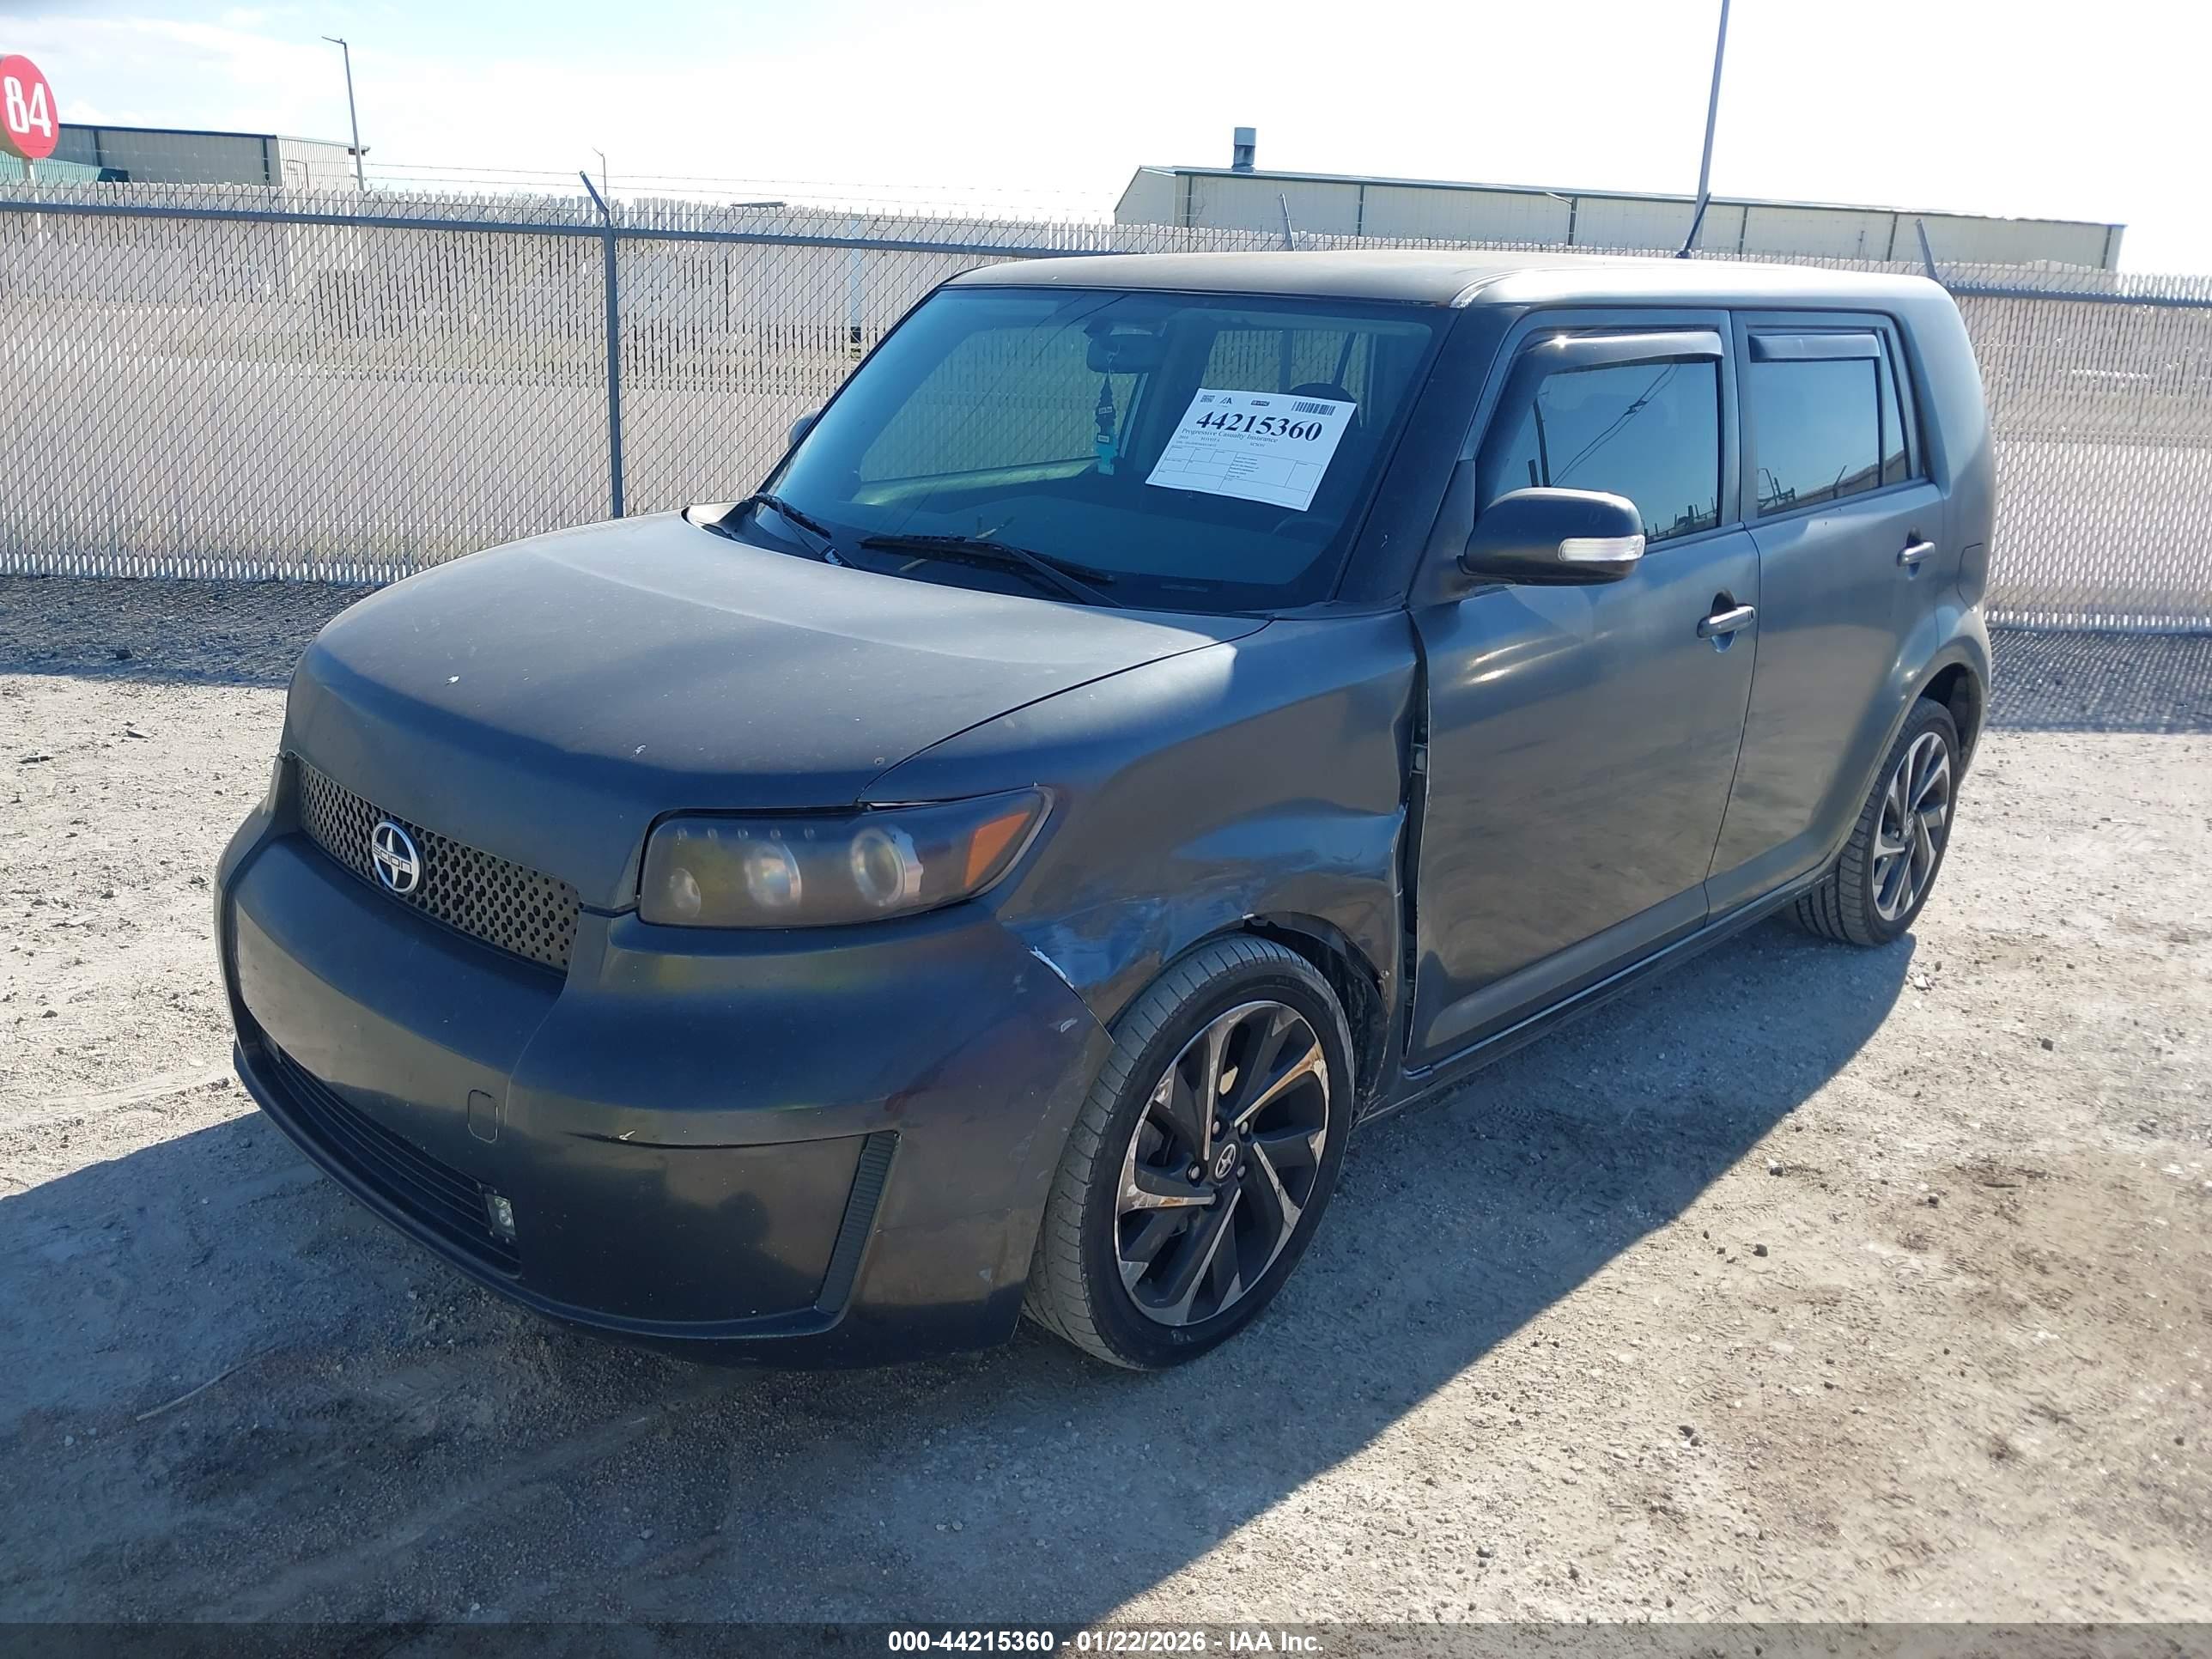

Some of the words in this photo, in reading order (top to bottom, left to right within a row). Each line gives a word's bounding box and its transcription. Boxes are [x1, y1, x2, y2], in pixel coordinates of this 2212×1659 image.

[3, 75, 52, 137] 84
[1182, 428, 1218, 436] Progressive
[1247, 434, 1279, 443] Insurance
[1195, 410, 1323, 441] 44215360
